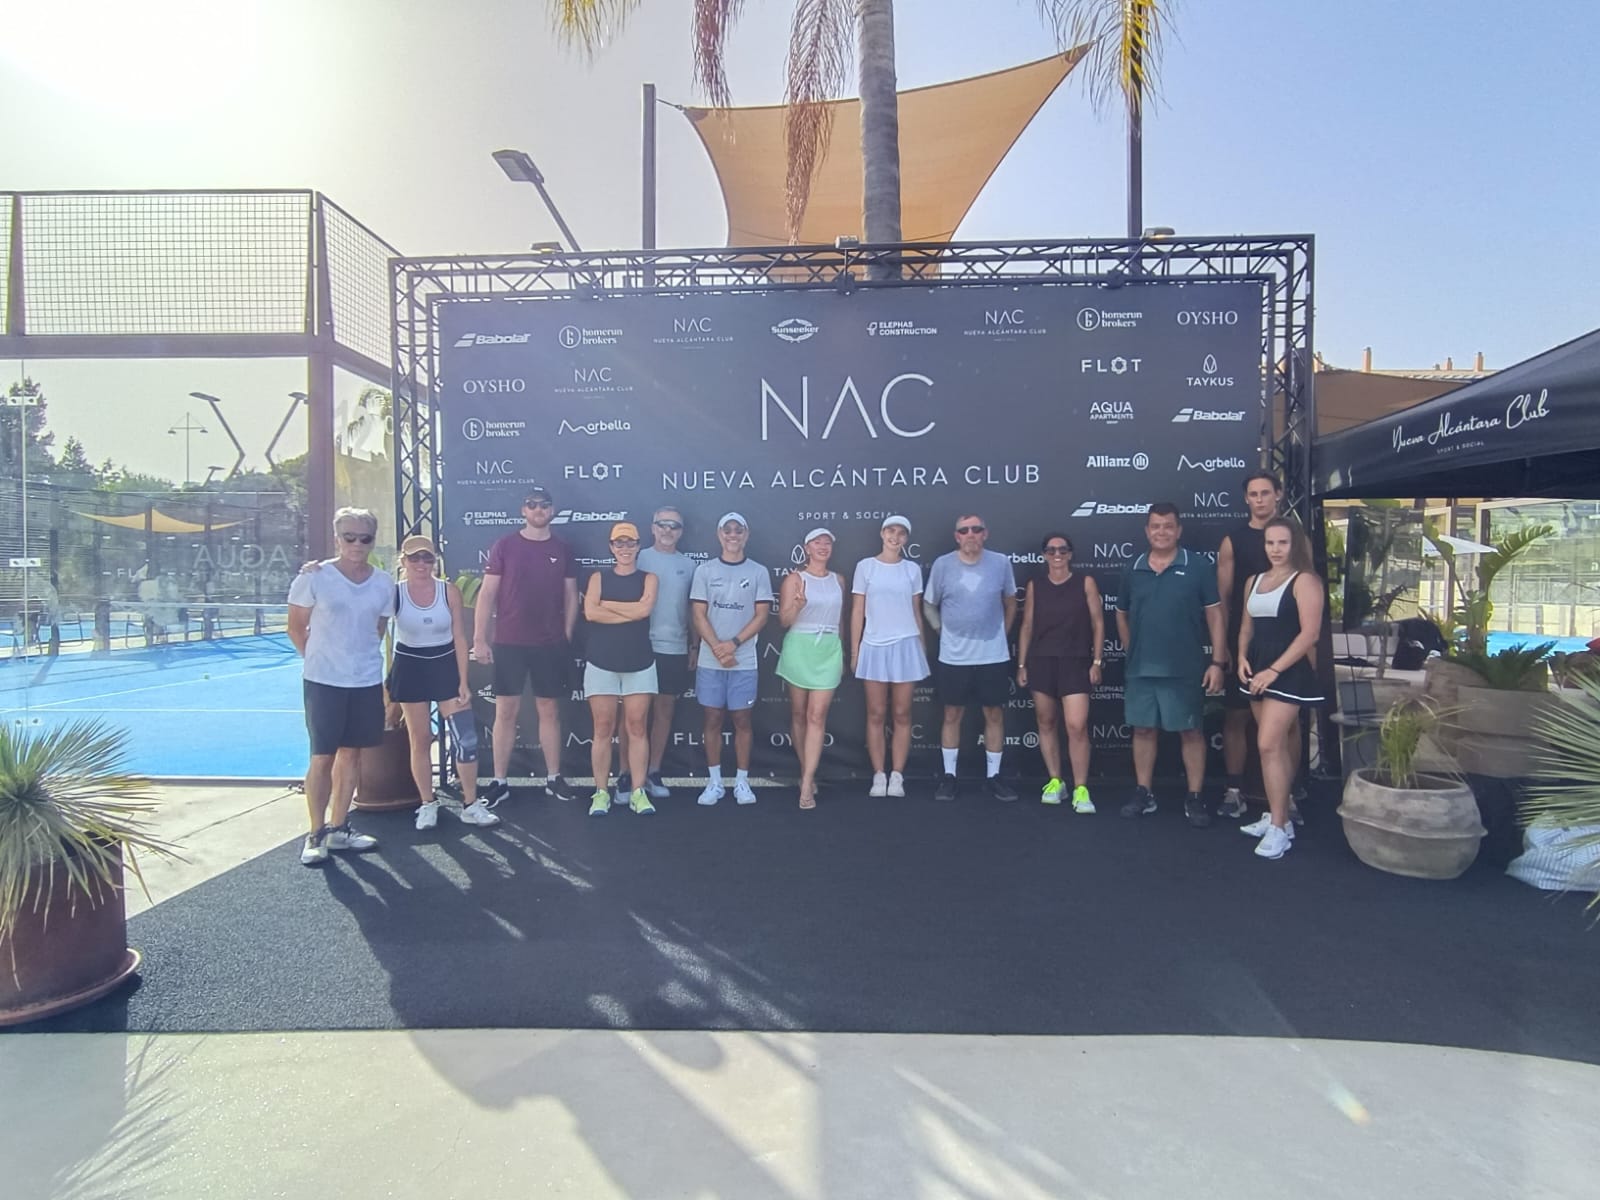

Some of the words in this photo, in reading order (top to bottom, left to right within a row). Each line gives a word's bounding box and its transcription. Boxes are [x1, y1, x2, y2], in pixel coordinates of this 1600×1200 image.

[985, 309, 1024, 325] NAC
[1101, 311, 1143, 319] homerun
[1177, 311, 1238, 326] OYSHO
[674, 317, 712, 333] NAC
[879, 321, 914, 329] ELEPHAS
[1101, 319, 1137, 328] brokers
[582, 327, 623, 336] homerun
[879, 327, 938, 336] CONSTRUCTION
[582, 336, 619, 345] brokers
[574, 367, 612, 383] NAC
[1186, 377, 1234, 386] TAYKUS
[463, 378, 526, 394] OYSHO
[761, 373, 936, 441] NAC
[1090, 402, 1133, 414] AQUA
[486, 421, 526, 430] homerun
[1393, 425, 1423, 453] Nueva
[1506, 388, 1550, 430] Club
[486, 428, 521, 437] brokers
[476, 459, 513, 475] NAC
[1087, 455, 1131, 468] Allianz
[662, 470, 756, 491] NUEVA
[771, 464, 948, 488] ALCÁNTARA
[964, 465, 1040, 486] CLUB
[1194, 491, 1230, 508] NAC
[474, 511, 507, 519] ELEPHAS
[798, 512, 836, 521] SPORT
[842, 511, 850, 521] &
[1094, 542, 1134, 559] NAC
[1092, 724, 1131, 739] NAC
